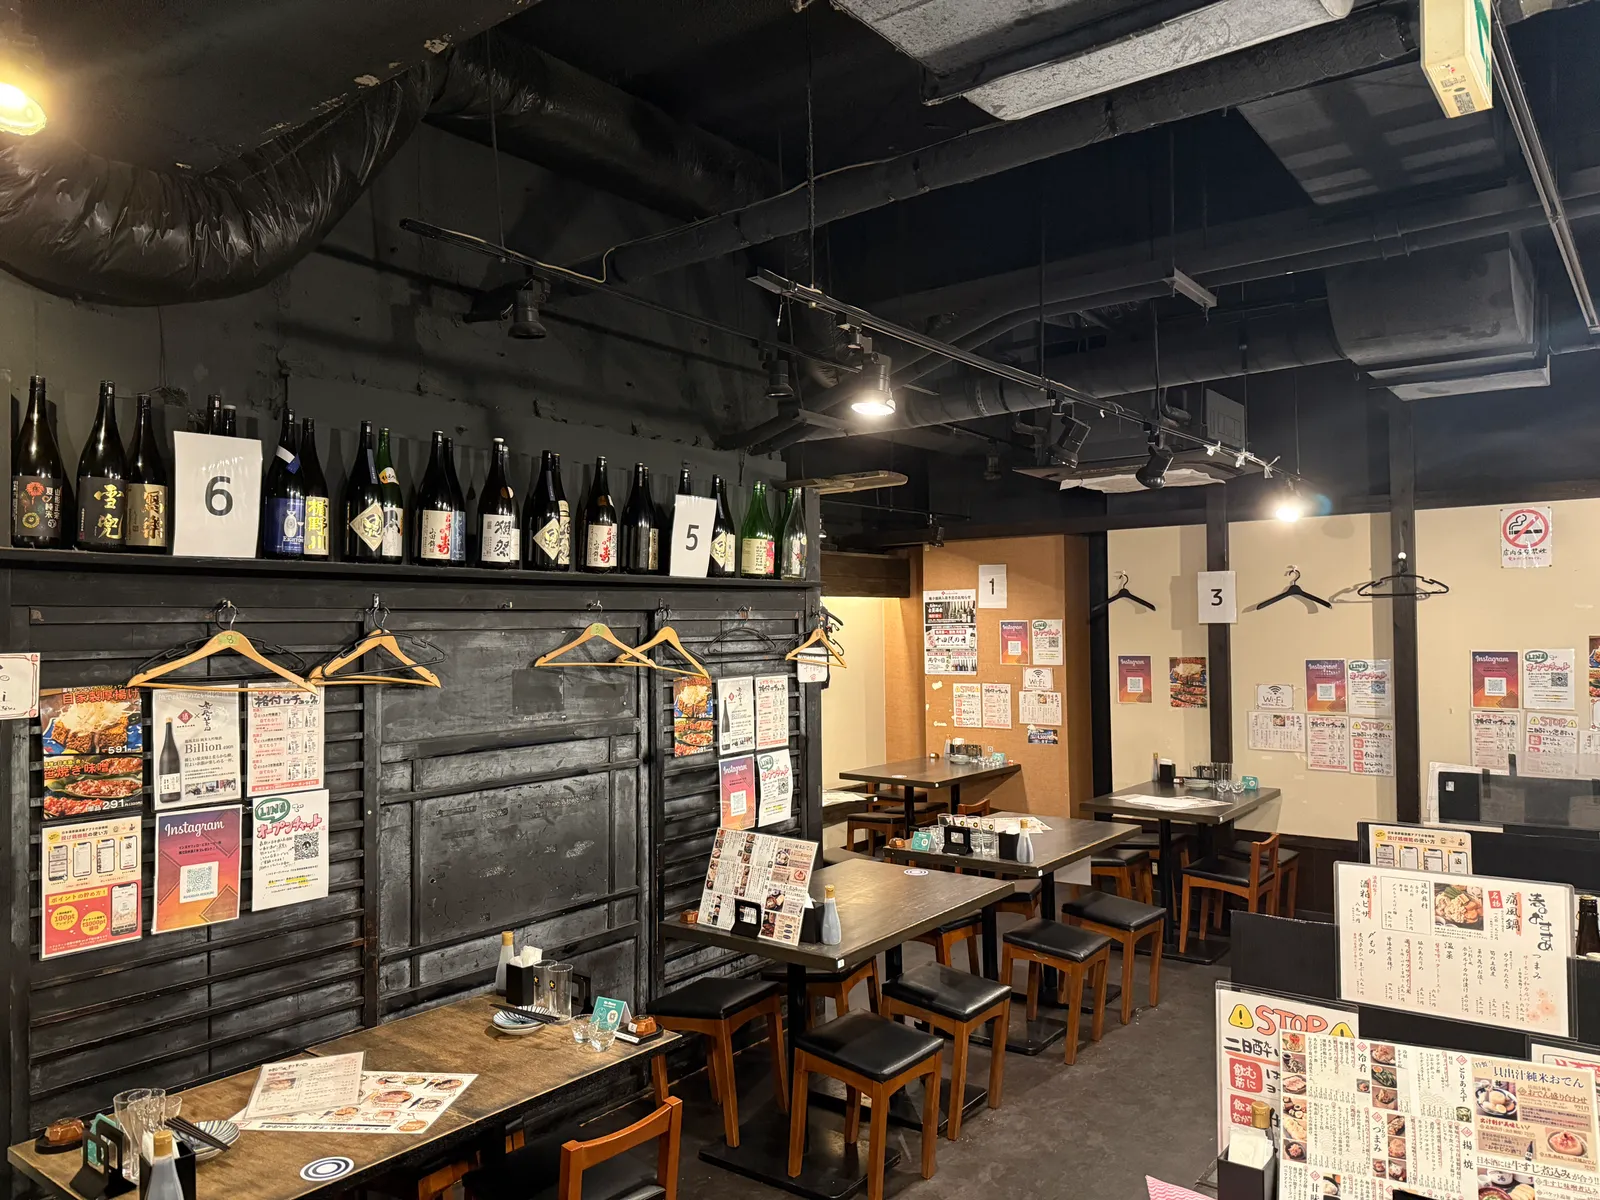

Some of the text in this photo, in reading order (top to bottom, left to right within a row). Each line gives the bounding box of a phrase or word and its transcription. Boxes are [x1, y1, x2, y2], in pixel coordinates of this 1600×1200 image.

[204, 476, 233, 517] 6
[685, 524, 700, 551] 5
[989, 578, 995, 595] 1
[1210, 588, 1223, 606] 3
[1120, 658, 1145, 667] Instagram
[1475, 655, 1510, 664] Instagram
[62, 687, 140, 705] 自家製厚揚げ
[1361, 721, 1384, 731] STOP
[1540, 716, 1567, 728] STOP
[185, 742, 222, 754] Billion
[44, 764, 110, 778] 笹焼き味噌
[722, 763, 748, 775] Instagram
[260, 802, 286, 817] LINE
[164, 820, 225, 837] Instagram
[257, 813, 322, 839] オープンチャット
[1490, 891, 1501, 908] 名物
[54, 913, 76, 922] 100pt
[1505, 892, 1520, 932] 痛風鍋
[1532, 953, 1542, 980] つまみ
[1255, 1004, 1328, 1036] STOP
[1459, 1067, 1468, 1102] とりあえず
[1372, 1126, 1382, 1153] つまみ
